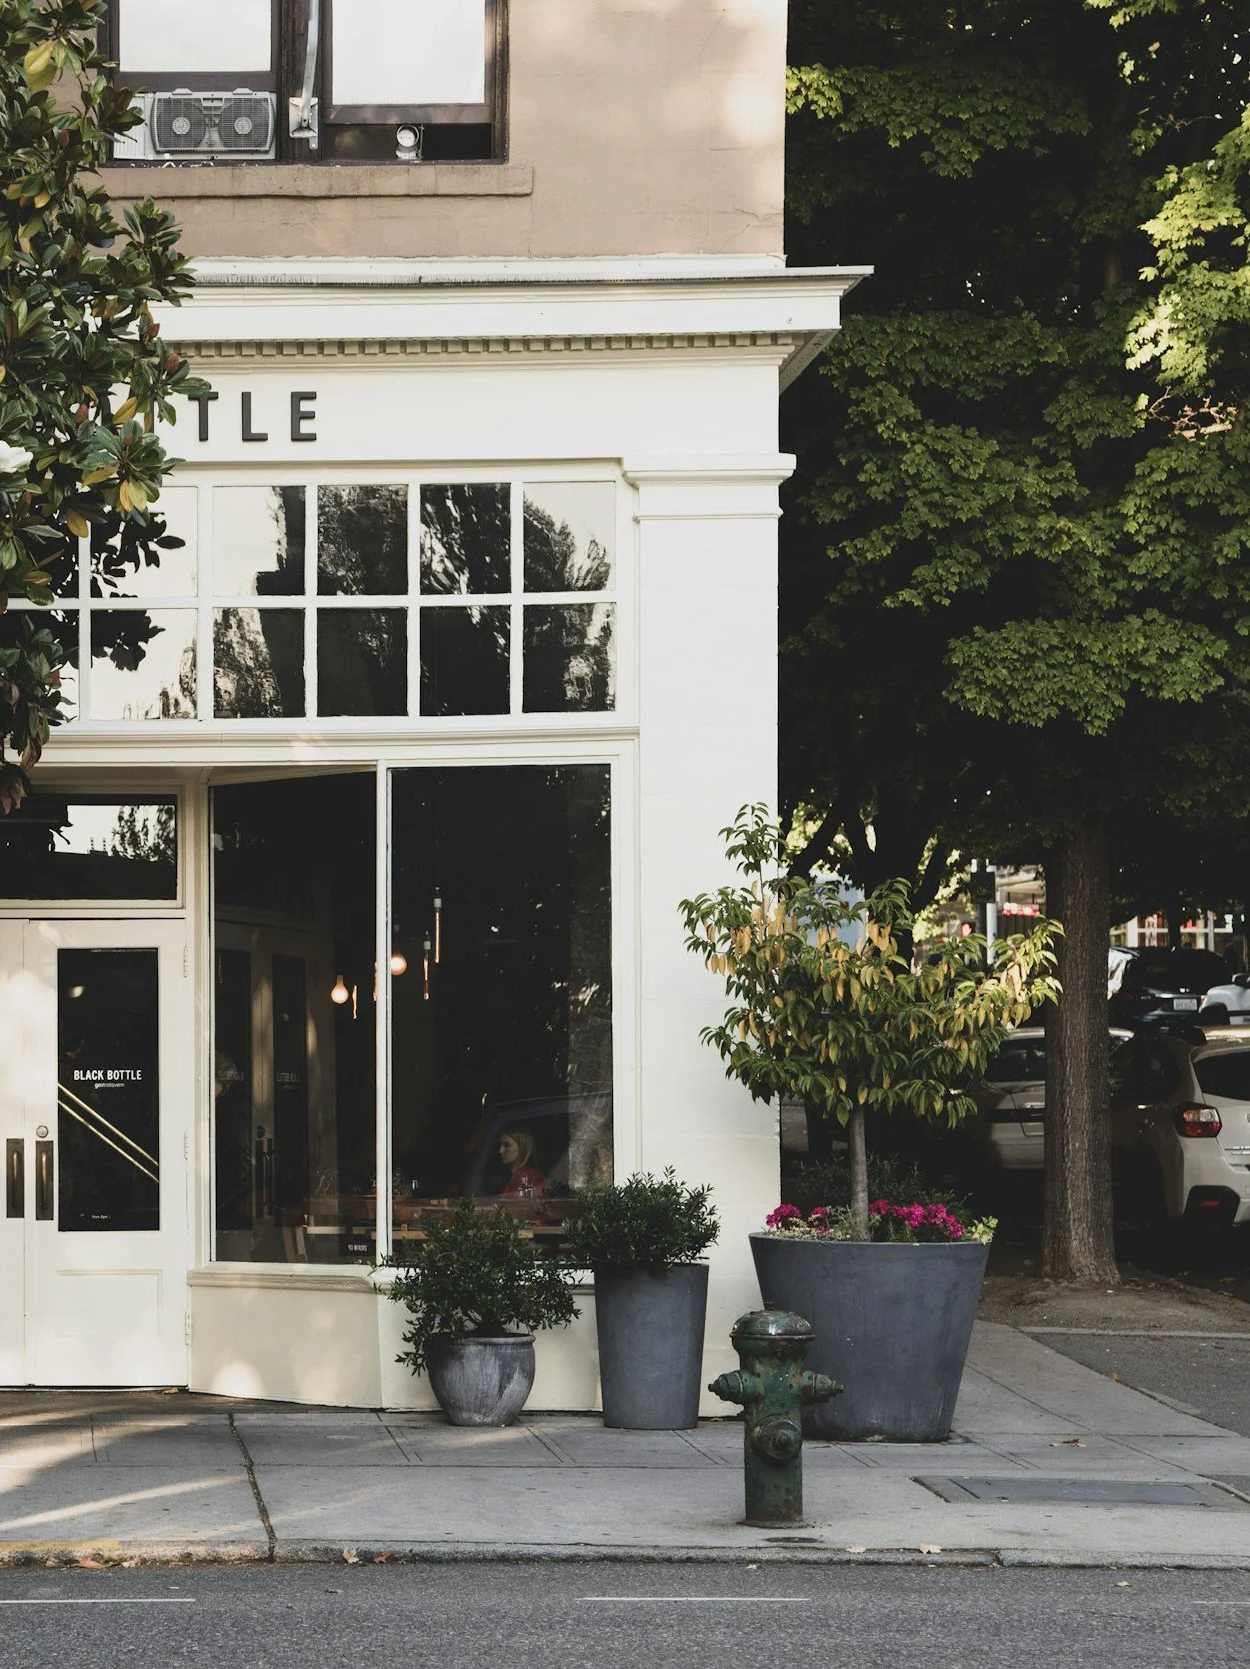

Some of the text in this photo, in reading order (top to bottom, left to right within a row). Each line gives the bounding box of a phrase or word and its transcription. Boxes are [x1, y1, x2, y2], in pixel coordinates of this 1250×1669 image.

[151, 391, 317, 442] TLE
[73, 1069, 142, 1081] BLACK BOTTLE
[94, 1082, 125, 1090] gastrotavern
